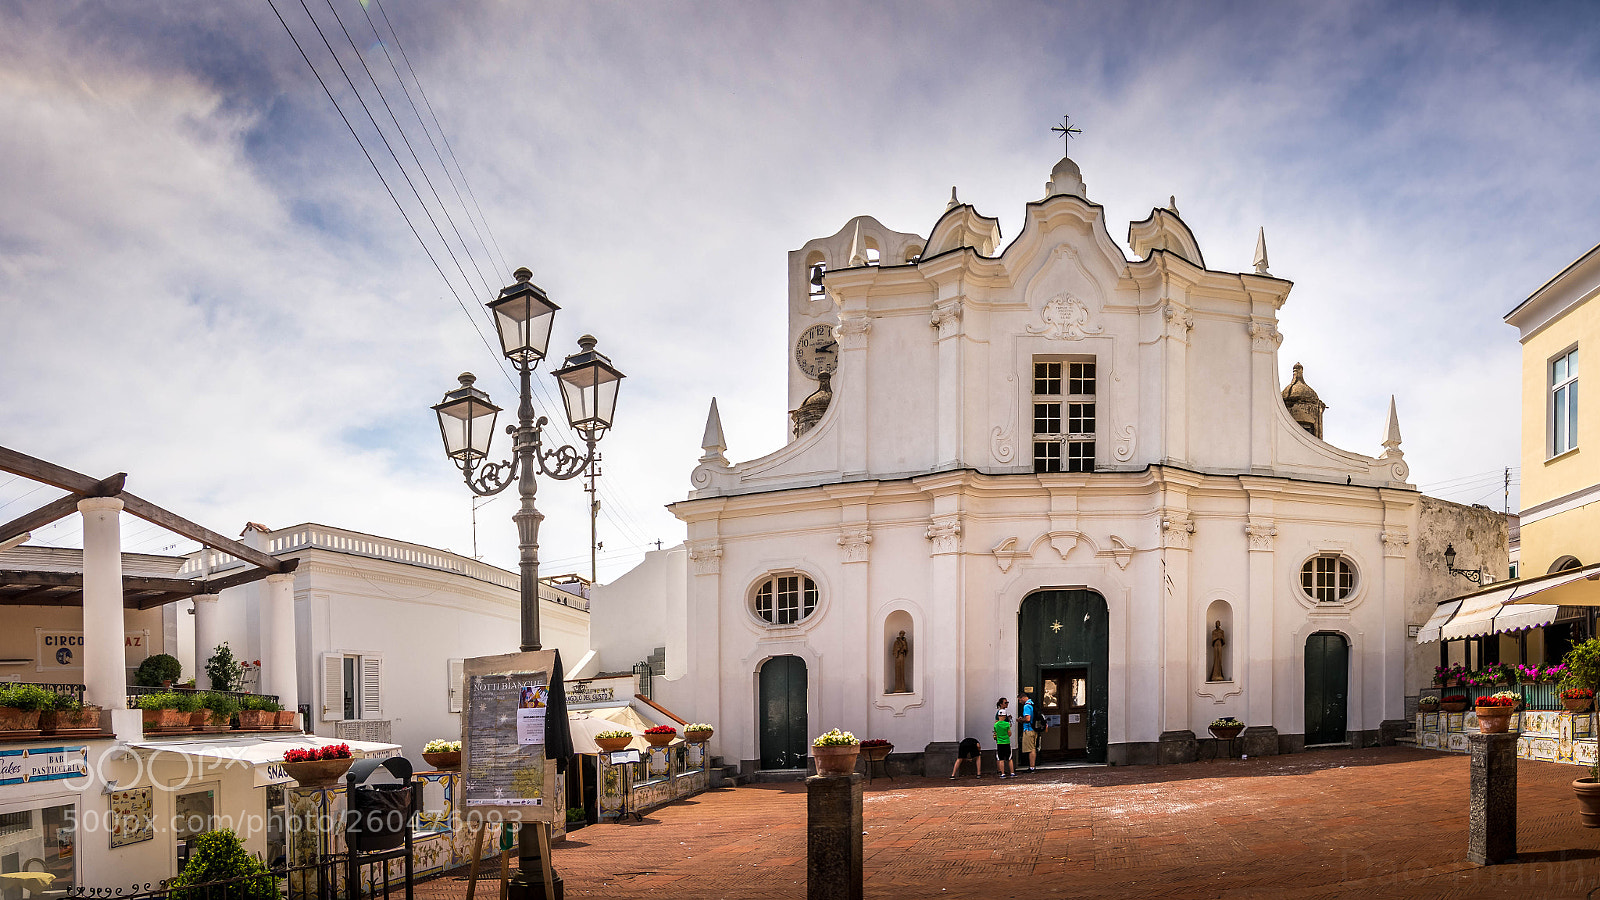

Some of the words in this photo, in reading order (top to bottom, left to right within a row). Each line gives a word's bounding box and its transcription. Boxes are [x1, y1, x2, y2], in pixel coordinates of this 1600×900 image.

[802, 339, 809, 347] 10
[45, 636, 84, 646] CIRCO
[124, 637, 141, 647] AZ
[474, 682, 500, 692] NOTTI
[49, 755, 64, 764] BAR
[32, 764, 80, 775] PASTICCERIA
[267, 765, 289, 780] SNAC
